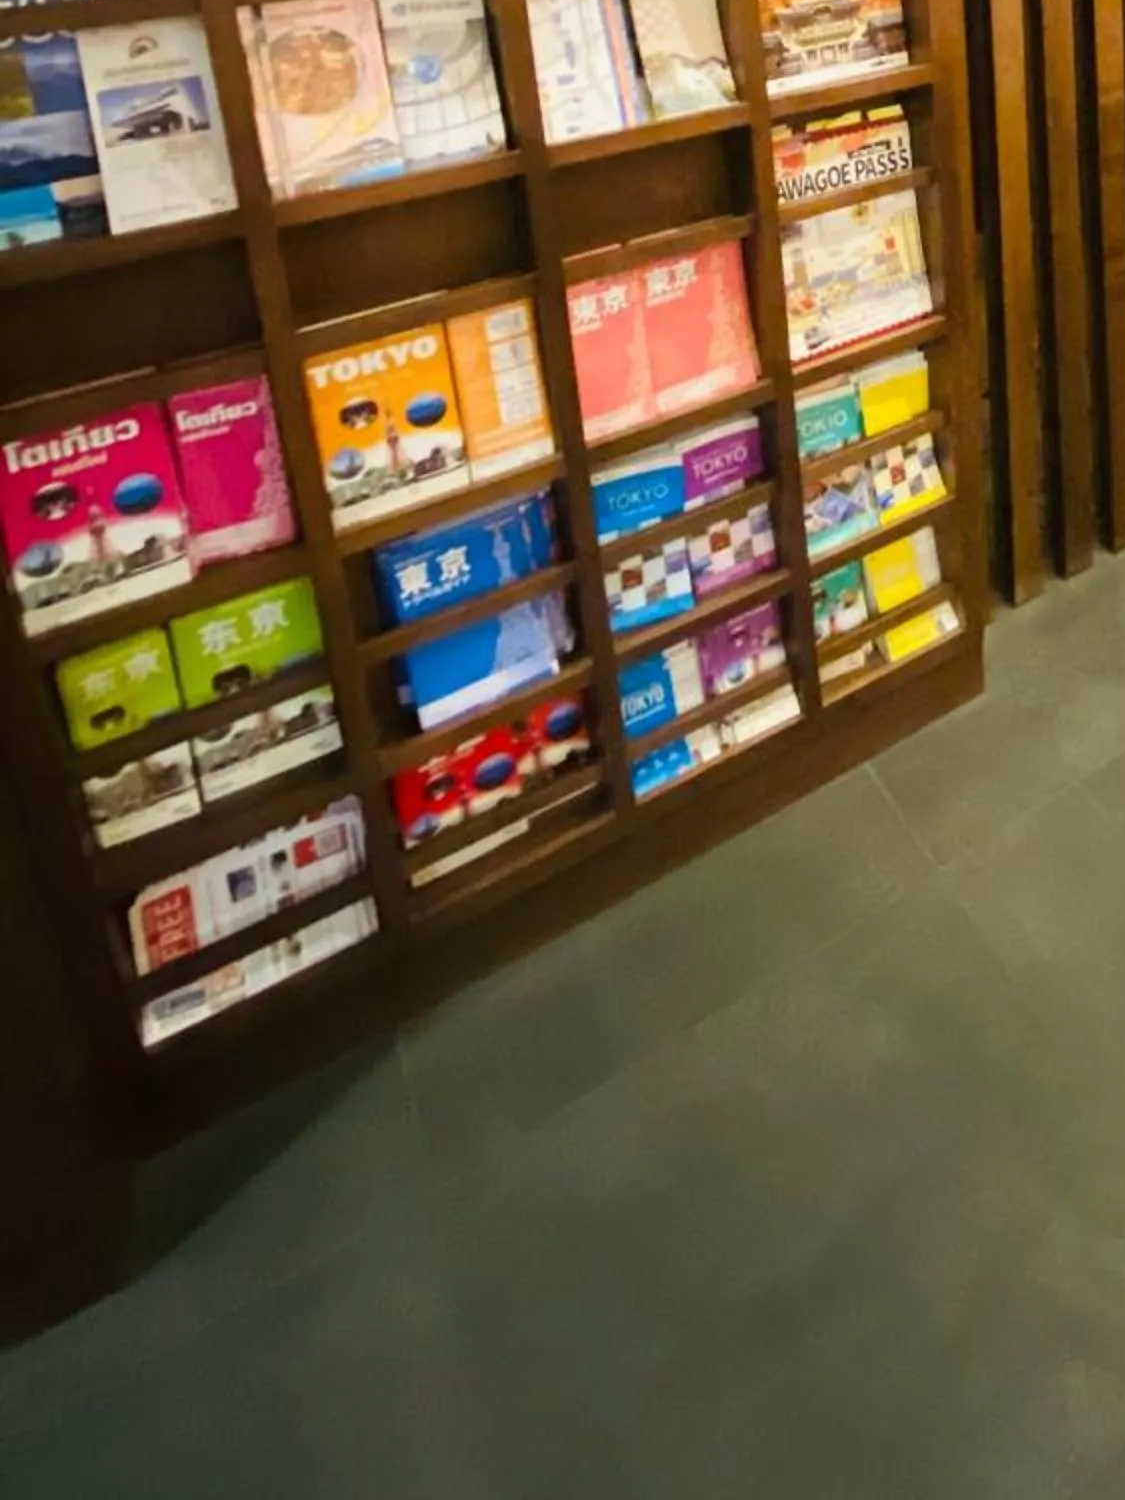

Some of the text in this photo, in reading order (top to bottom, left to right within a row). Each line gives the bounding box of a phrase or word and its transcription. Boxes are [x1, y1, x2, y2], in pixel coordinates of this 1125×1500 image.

[776, 162, 851, 201] AWAGOE
[306, 334, 440, 390] TOKYO
[692, 444, 748, 480] TOKYO
[607, 482, 670, 511] TOKYO
[394, 544, 472, 600] 東京
